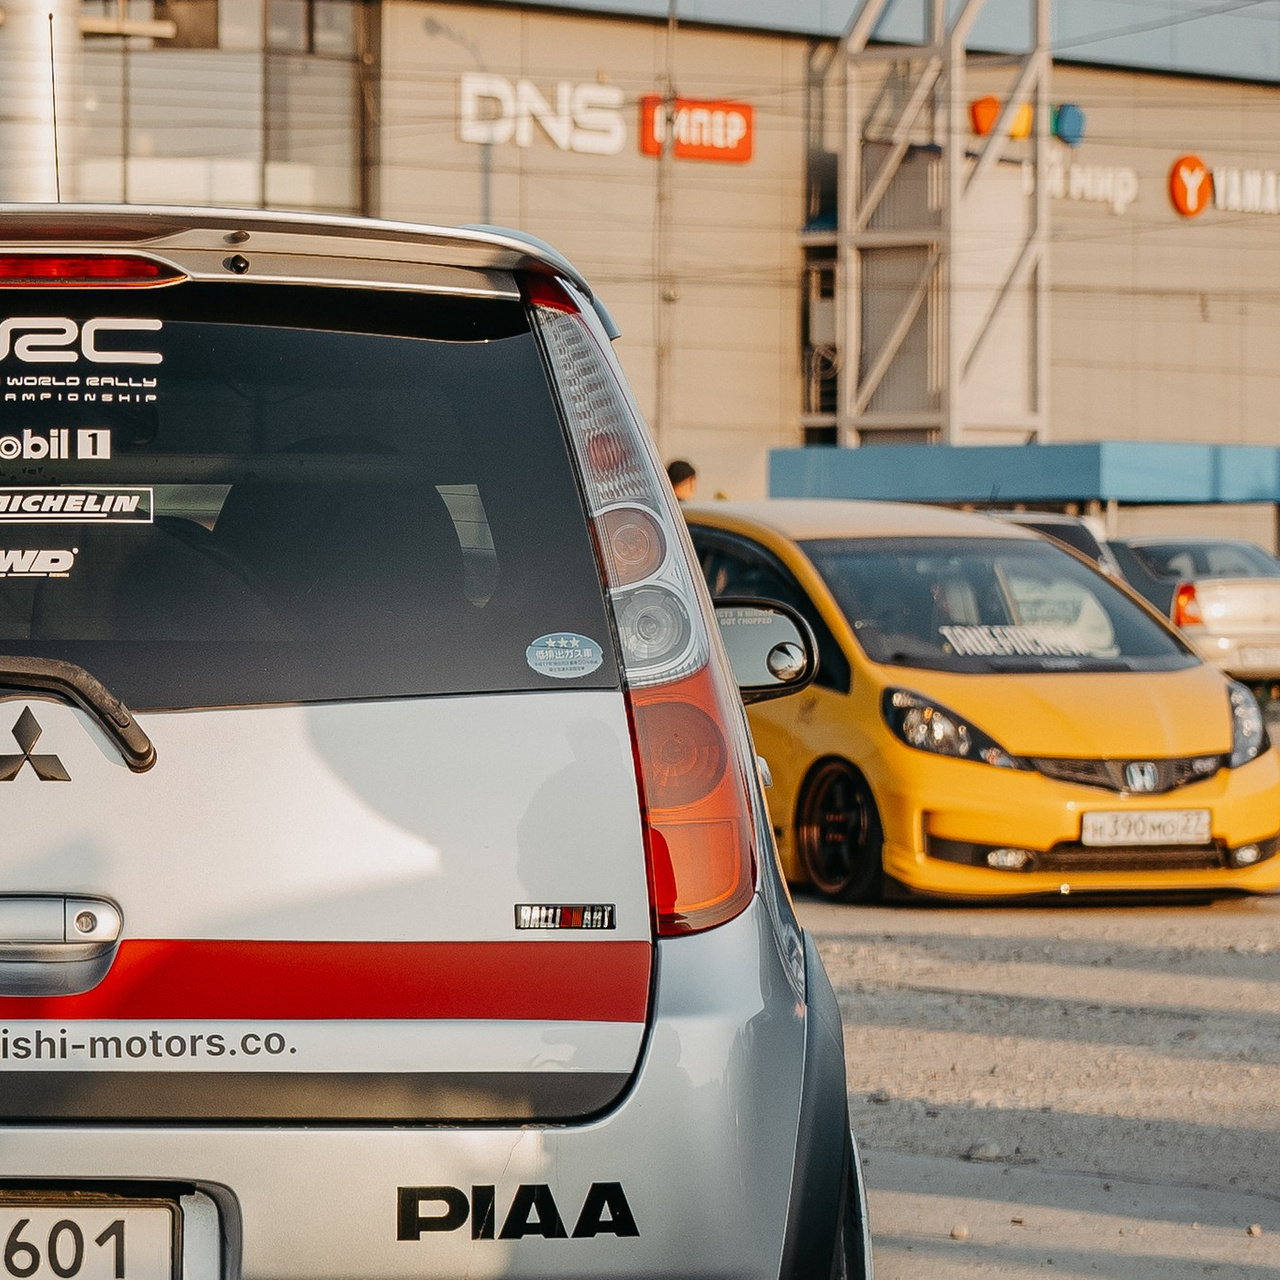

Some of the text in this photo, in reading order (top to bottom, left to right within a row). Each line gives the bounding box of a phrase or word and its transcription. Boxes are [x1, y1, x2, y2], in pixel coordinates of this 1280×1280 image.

[460, 72, 626, 155] DNS
[6, 376, 80, 387] WORLD
[86, 377, 157, 388] RALLY
[396, 1181, 641, 1241] PIAA
[4, 1218, 126, 1280] 601
